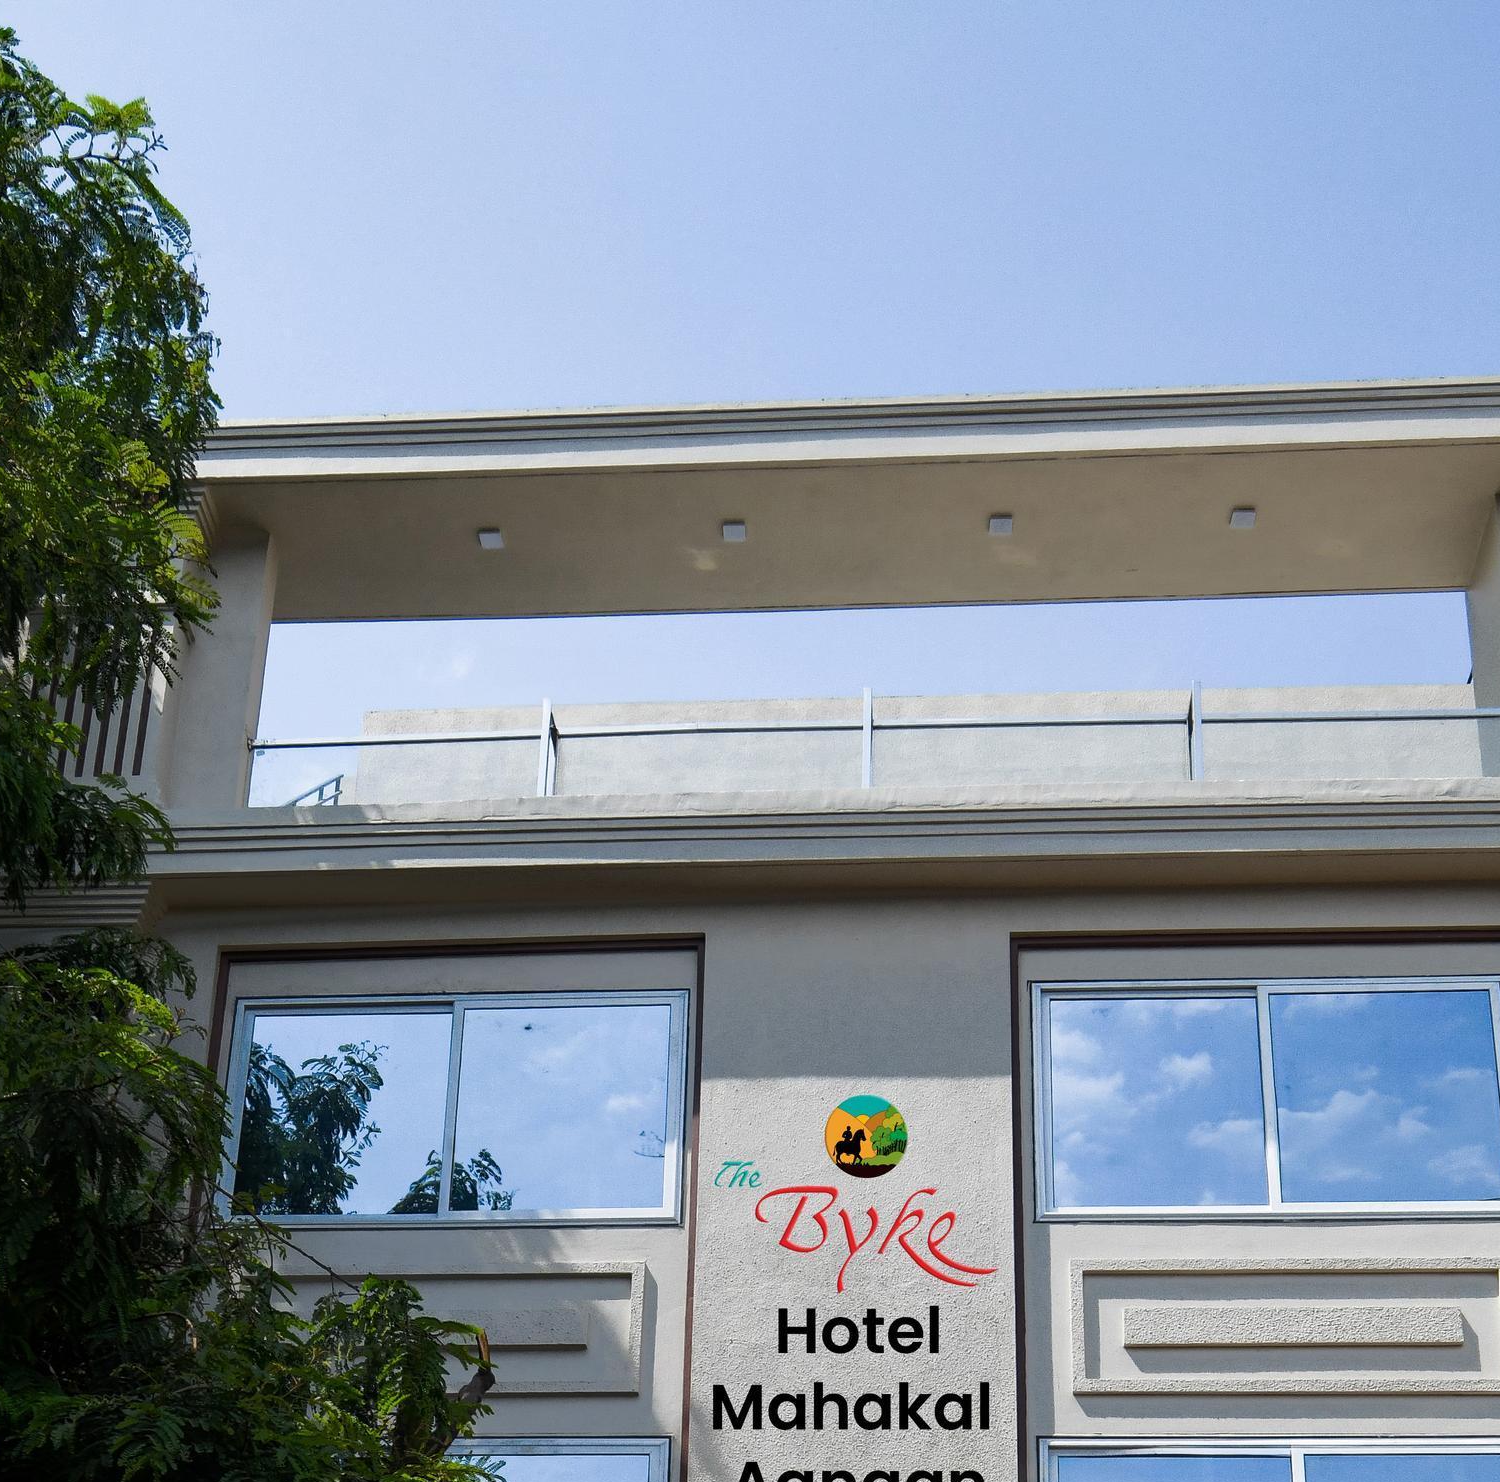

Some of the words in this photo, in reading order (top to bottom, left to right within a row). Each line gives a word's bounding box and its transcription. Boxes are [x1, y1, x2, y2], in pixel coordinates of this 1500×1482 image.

[713, 1161, 762, 1188] The
[754, 1185, 998, 1293] Byke
[777, 1306, 940, 1354] Hotel
[712, 1382, 990, 1430] Mahakal
